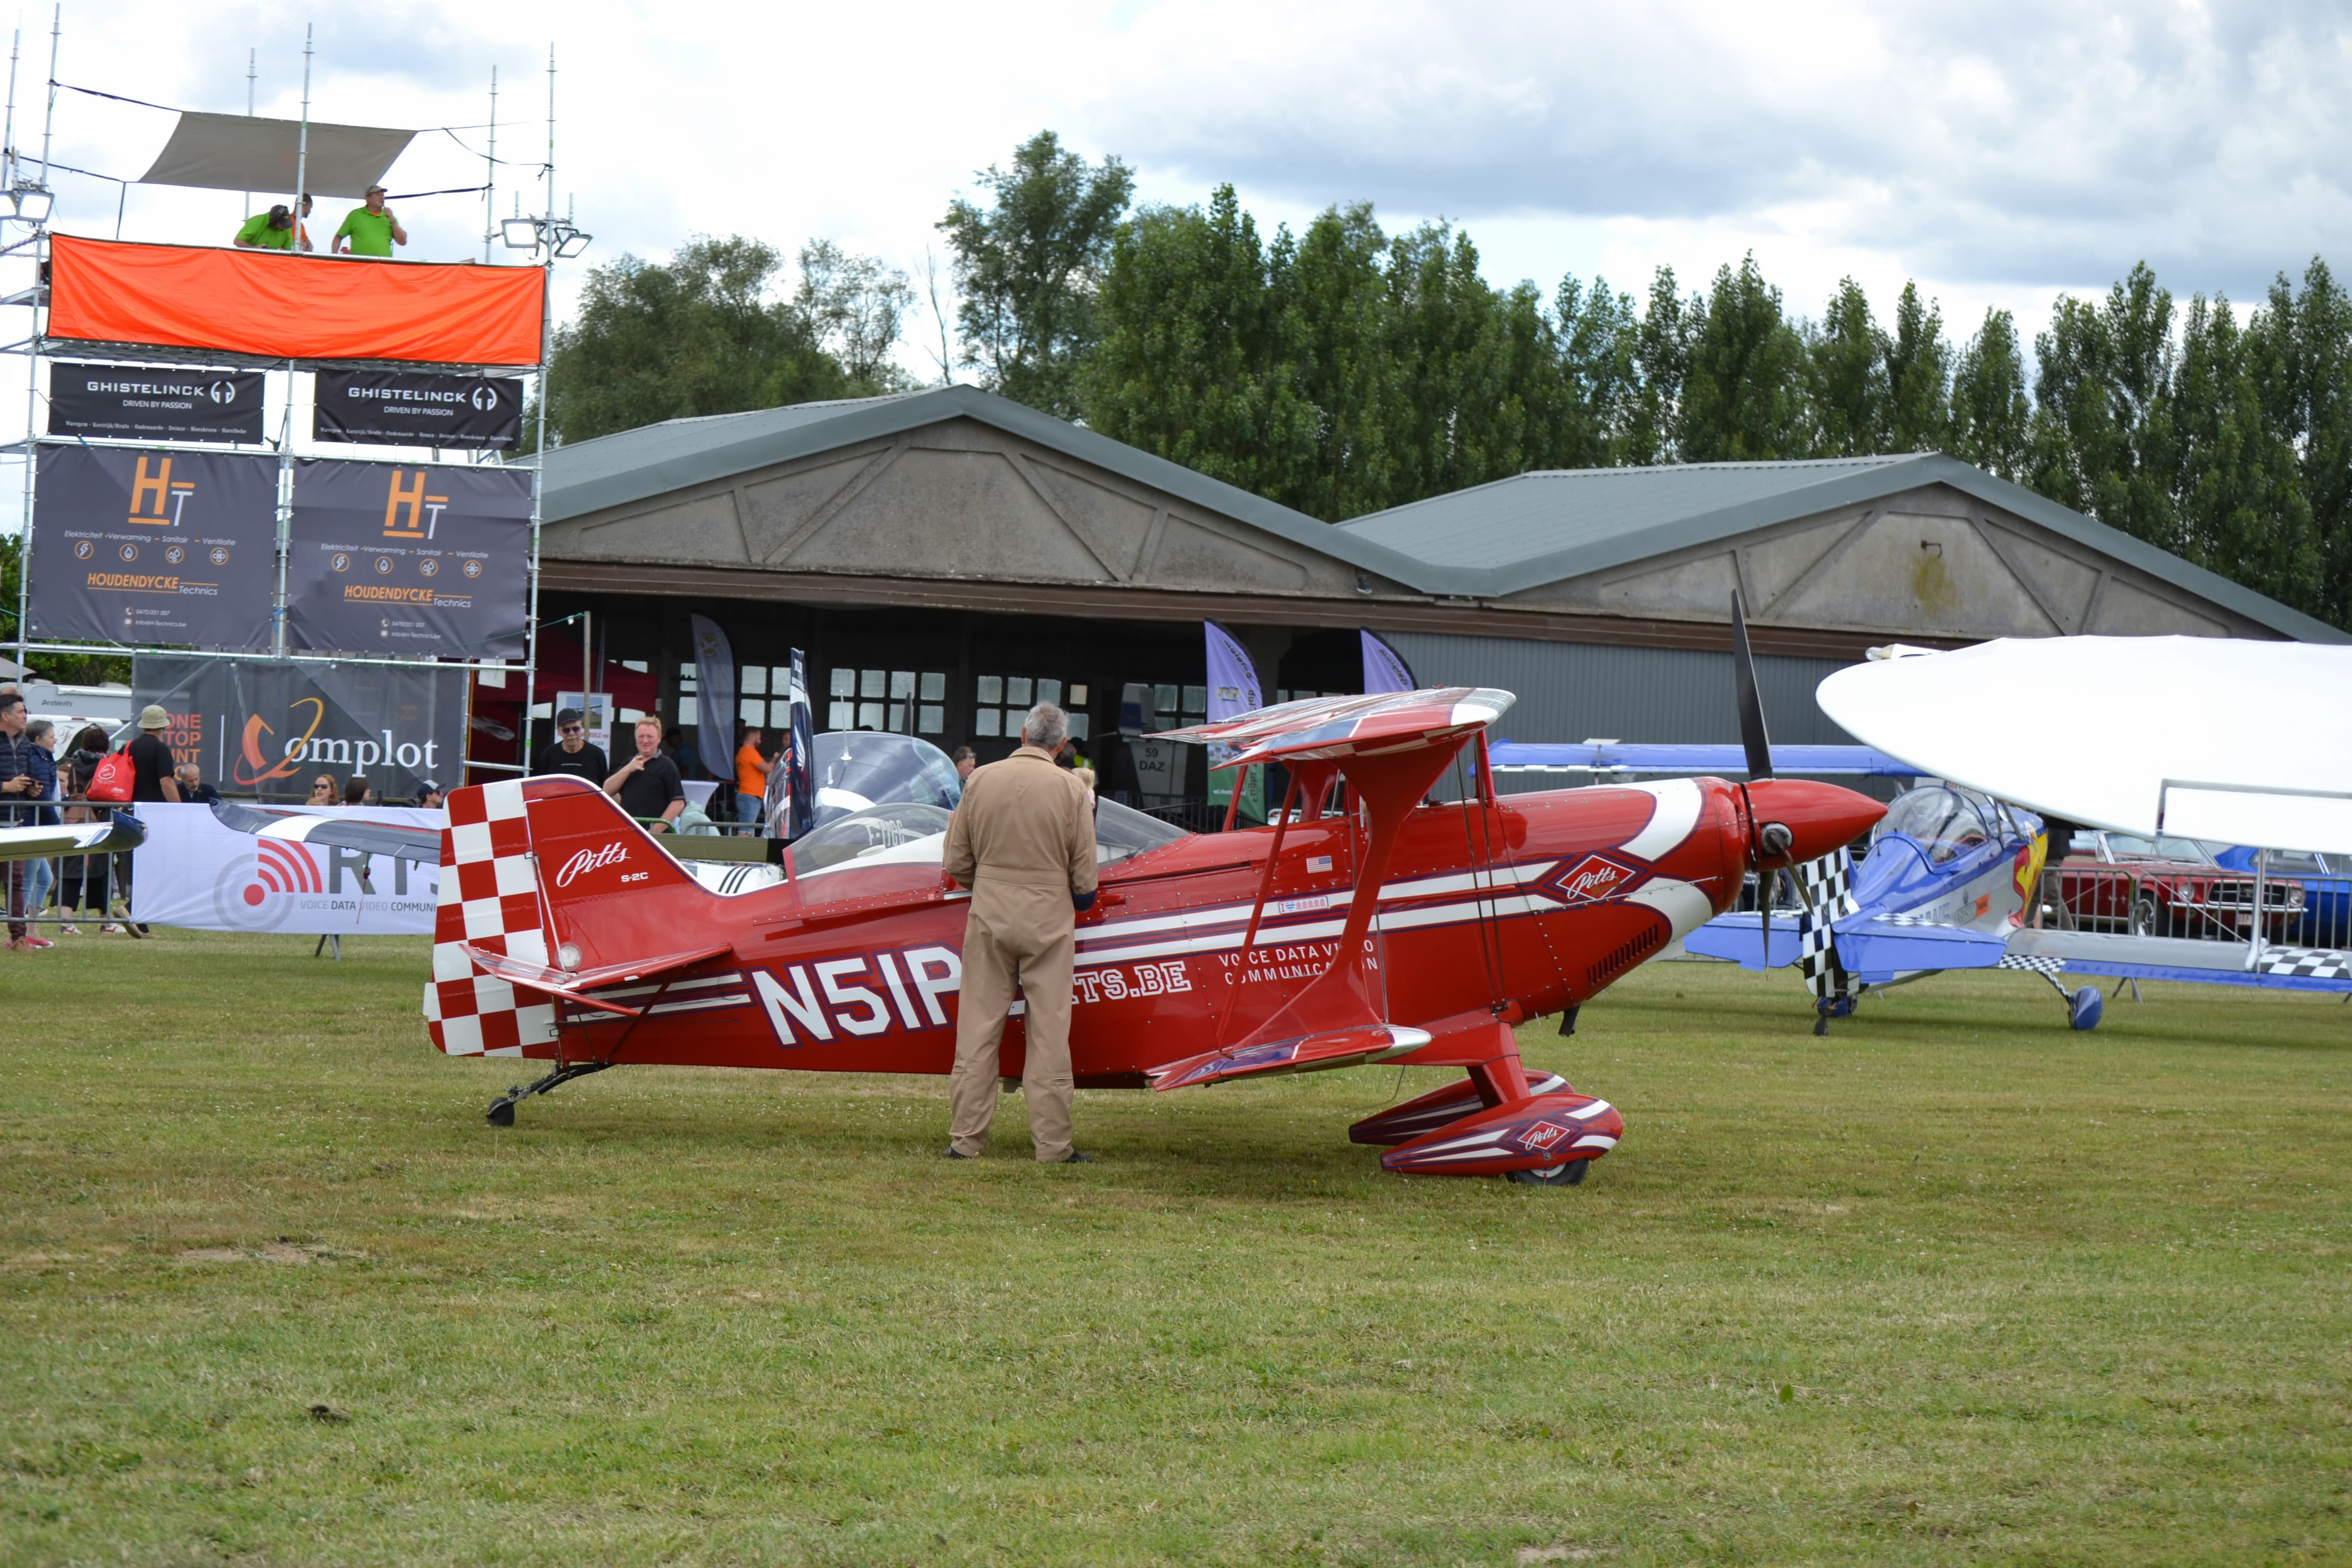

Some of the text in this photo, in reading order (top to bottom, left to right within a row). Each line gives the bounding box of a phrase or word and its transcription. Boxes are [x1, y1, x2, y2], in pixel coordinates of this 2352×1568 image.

[87, 381, 205, 397] GHISTELINCK
[348, 387, 467, 403] GHISTELINCK
[122, 400, 150, 408] DRIVEN
[160, 401, 192, 409] PASSION
[383, 406, 411, 414] DRIVEN
[422, 408, 454, 416] PASSION
[64, 530, 236, 546] Elektriciteit Verwarming Sanitair Ventilatie
[321, 543, 489, 559] Elektriciteit Verwarming Sanitair Ventilatie
[87, 572, 218, 596] HOUDENDYCKE Technics
[344, 585, 472, 608] HOUDENDYCKE Technics
[235, 698, 439, 784] Complot
[1145, 747, 1159, 757] 59
[1139, 761, 1165, 772] DAZ
[556, 842, 632, 888] Pitts
[1567, 866, 1619, 899] Pitts
[300, 900, 329, 910] VOICE
[331, 900, 356, 911] DATA
[359, 900, 388, 911] VIDEO
[1218, 950, 1271, 967] VOCE
[1276, 945, 1319, 962] DATA
[1072, 960, 1193, 1004] TS.BE
[1525, 1126, 1559, 1150] Pitts
